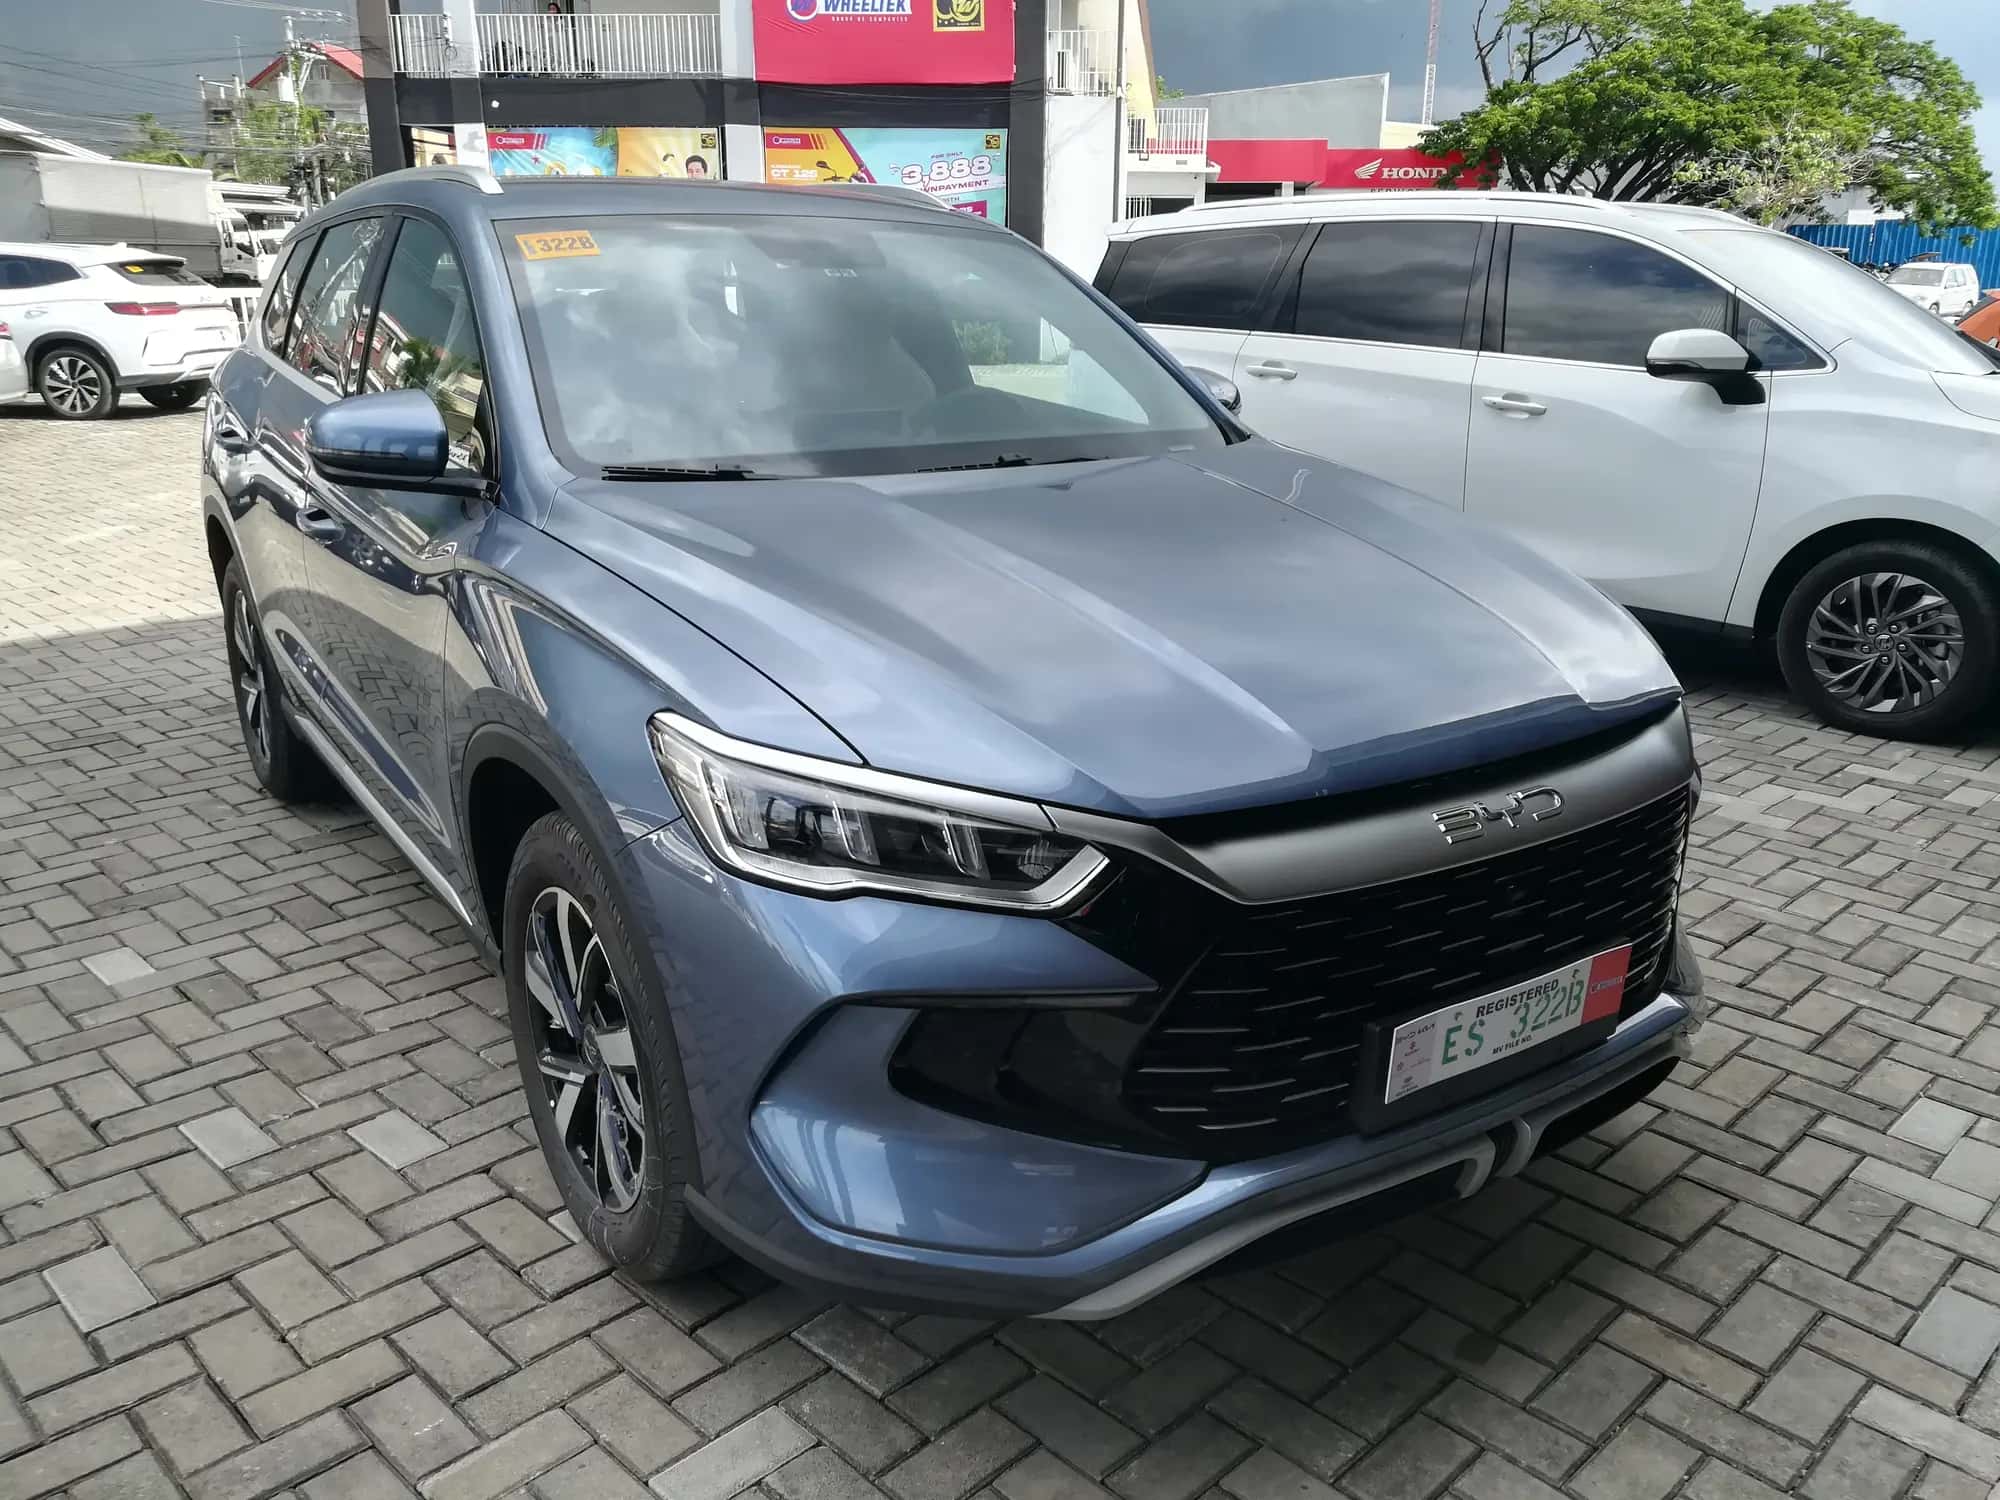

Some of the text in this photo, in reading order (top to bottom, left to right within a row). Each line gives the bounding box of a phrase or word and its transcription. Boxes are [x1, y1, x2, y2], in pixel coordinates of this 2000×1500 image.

[1381, 167, 1465, 179] HOND
[921, 179, 989, 193] WNPAYMENT
[1431, 784, 1565, 845] BYD
[1476, 978, 1559, 1019] REGISTERED
[1505, 1038, 1520, 1051] FILE
